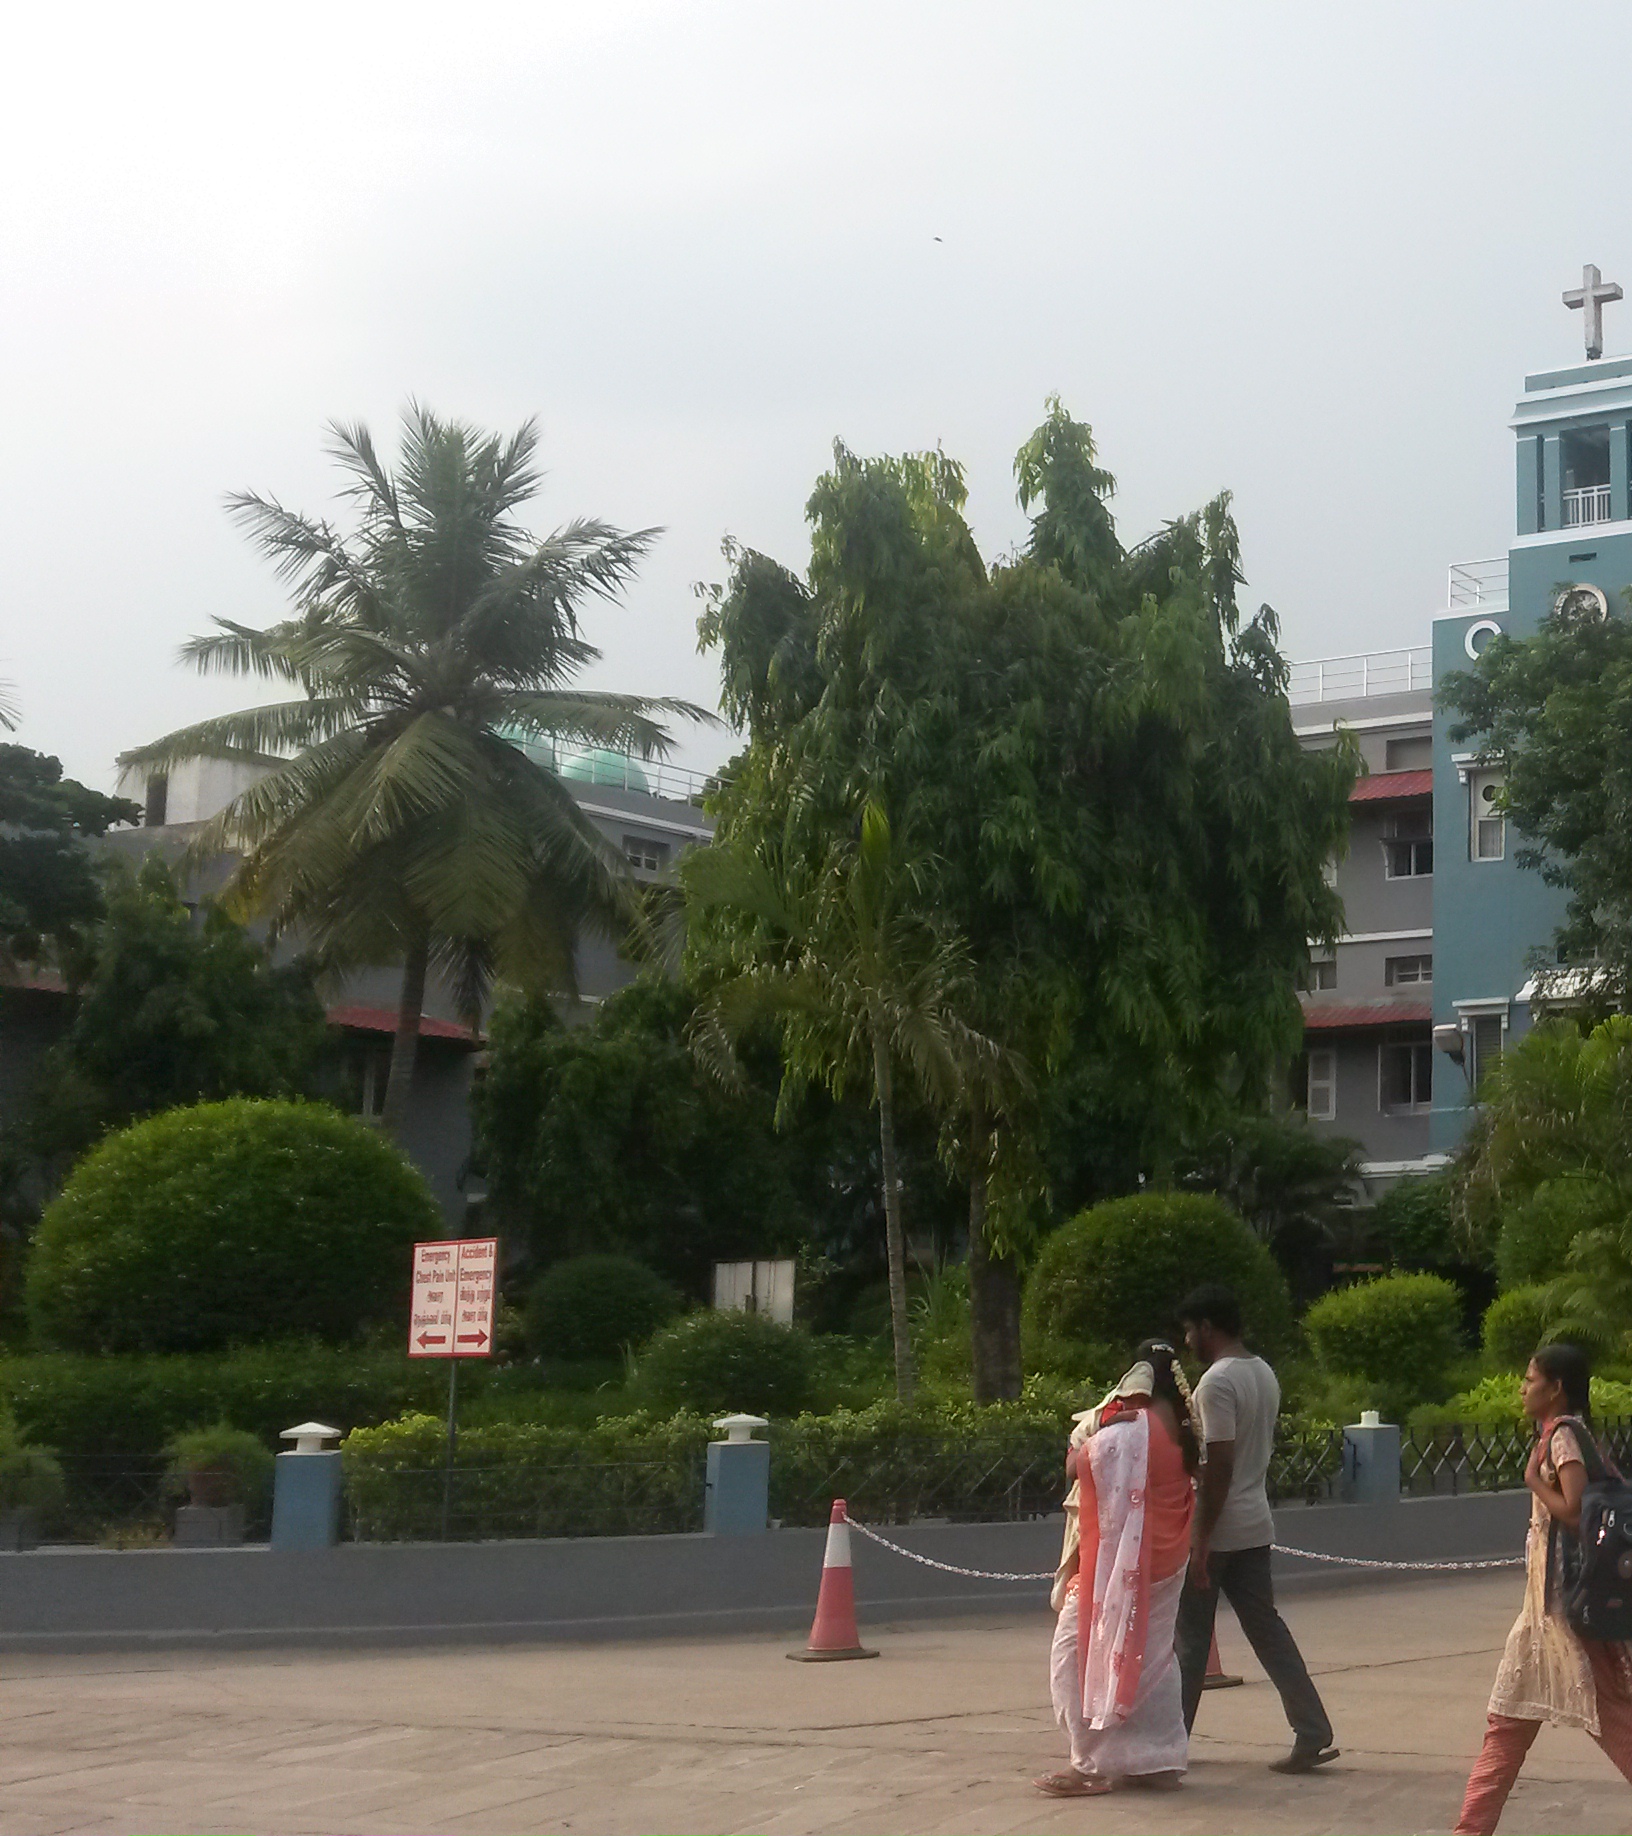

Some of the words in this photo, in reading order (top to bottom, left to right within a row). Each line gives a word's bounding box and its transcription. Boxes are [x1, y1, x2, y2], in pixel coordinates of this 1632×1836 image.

[421, 1249, 450, 1265] Emergency
[462, 1245, 487, 1259] Accident
[416, 1270, 431, 1284] Chest
[432, 1269, 444, 1282] Pain
[460, 1267, 492, 1284] Emergency
